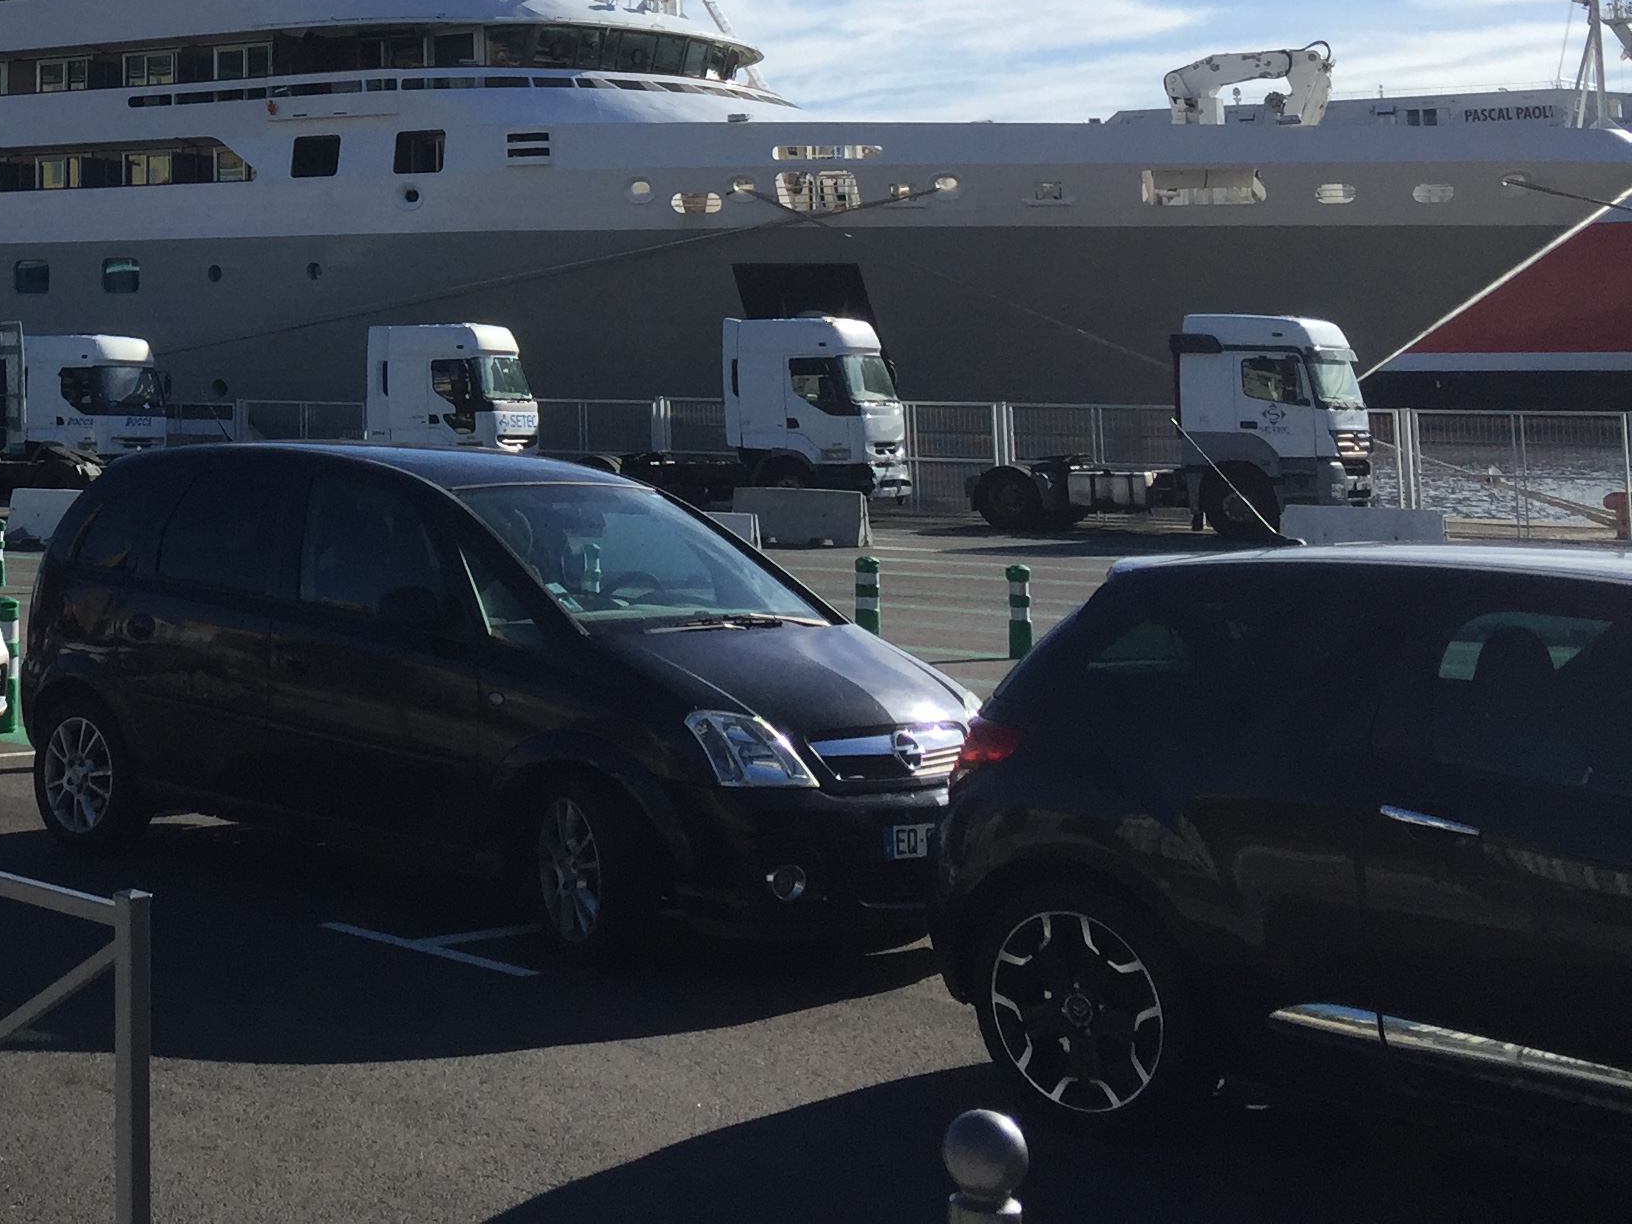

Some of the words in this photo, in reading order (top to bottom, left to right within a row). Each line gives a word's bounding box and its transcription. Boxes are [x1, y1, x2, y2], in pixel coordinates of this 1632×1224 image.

[1464, 107, 1513, 122] PASCAL
[1515, 104, 1554, 120] PAOLI
[510, 414, 537, 428] SETEC
